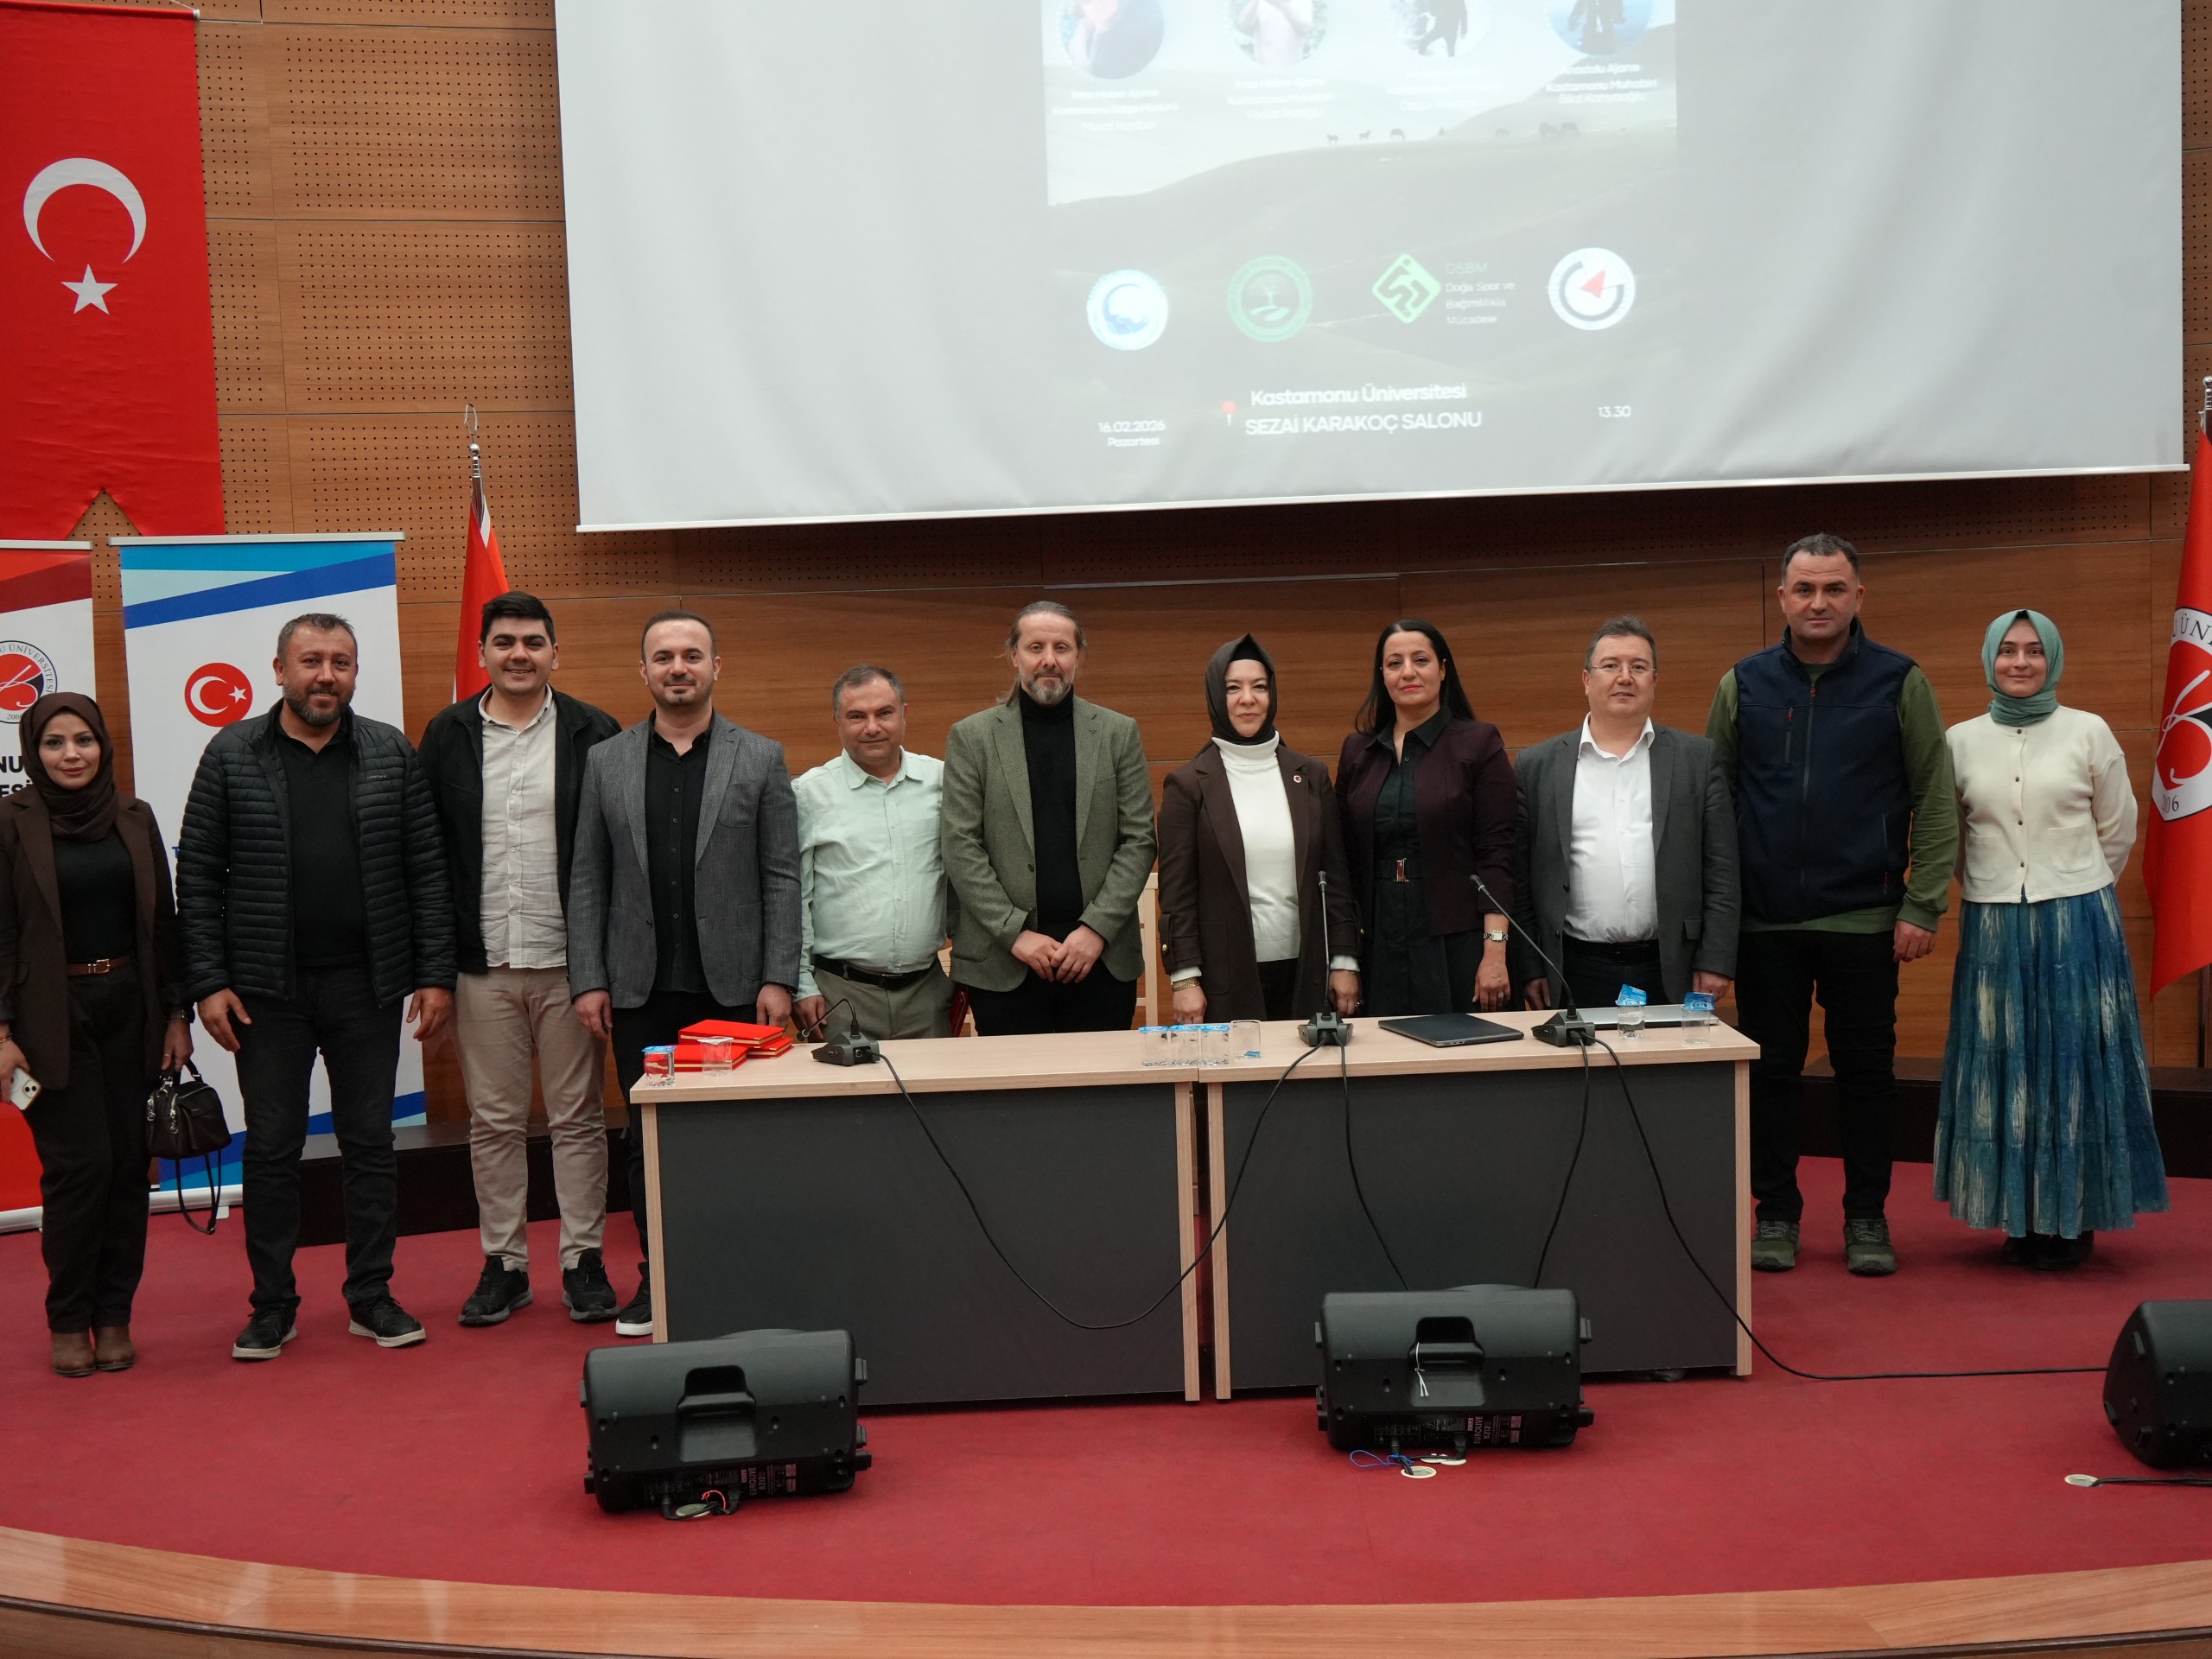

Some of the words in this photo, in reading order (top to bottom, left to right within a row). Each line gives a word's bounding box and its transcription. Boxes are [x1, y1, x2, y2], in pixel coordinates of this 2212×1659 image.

[1445, 262, 1488, 275] DSBM
[1446, 283, 1473, 294] Doğa
[1477, 282, 1500, 292] Spor
[1251, 390, 1358, 406] Kastamonu
[1362, 383, 1467, 403] Üniversitesi
[1598, 405, 1631, 417] 13.30
[1098, 420, 1166, 433] 16.02.2026
[1245, 414, 1298, 435] SEZAİ
[1303, 414, 1398, 434] KARAKOÇ
[1402, 411, 1482, 430] SALONU
[1108, 437, 1160, 447] Pazartesi
[9, 643, 54, 694] ÜNİVERSİTESİ
[1473, 1416, 1483, 1444] EUROLIVE
[748, 1467, 757, 1496] EUROLIVE
